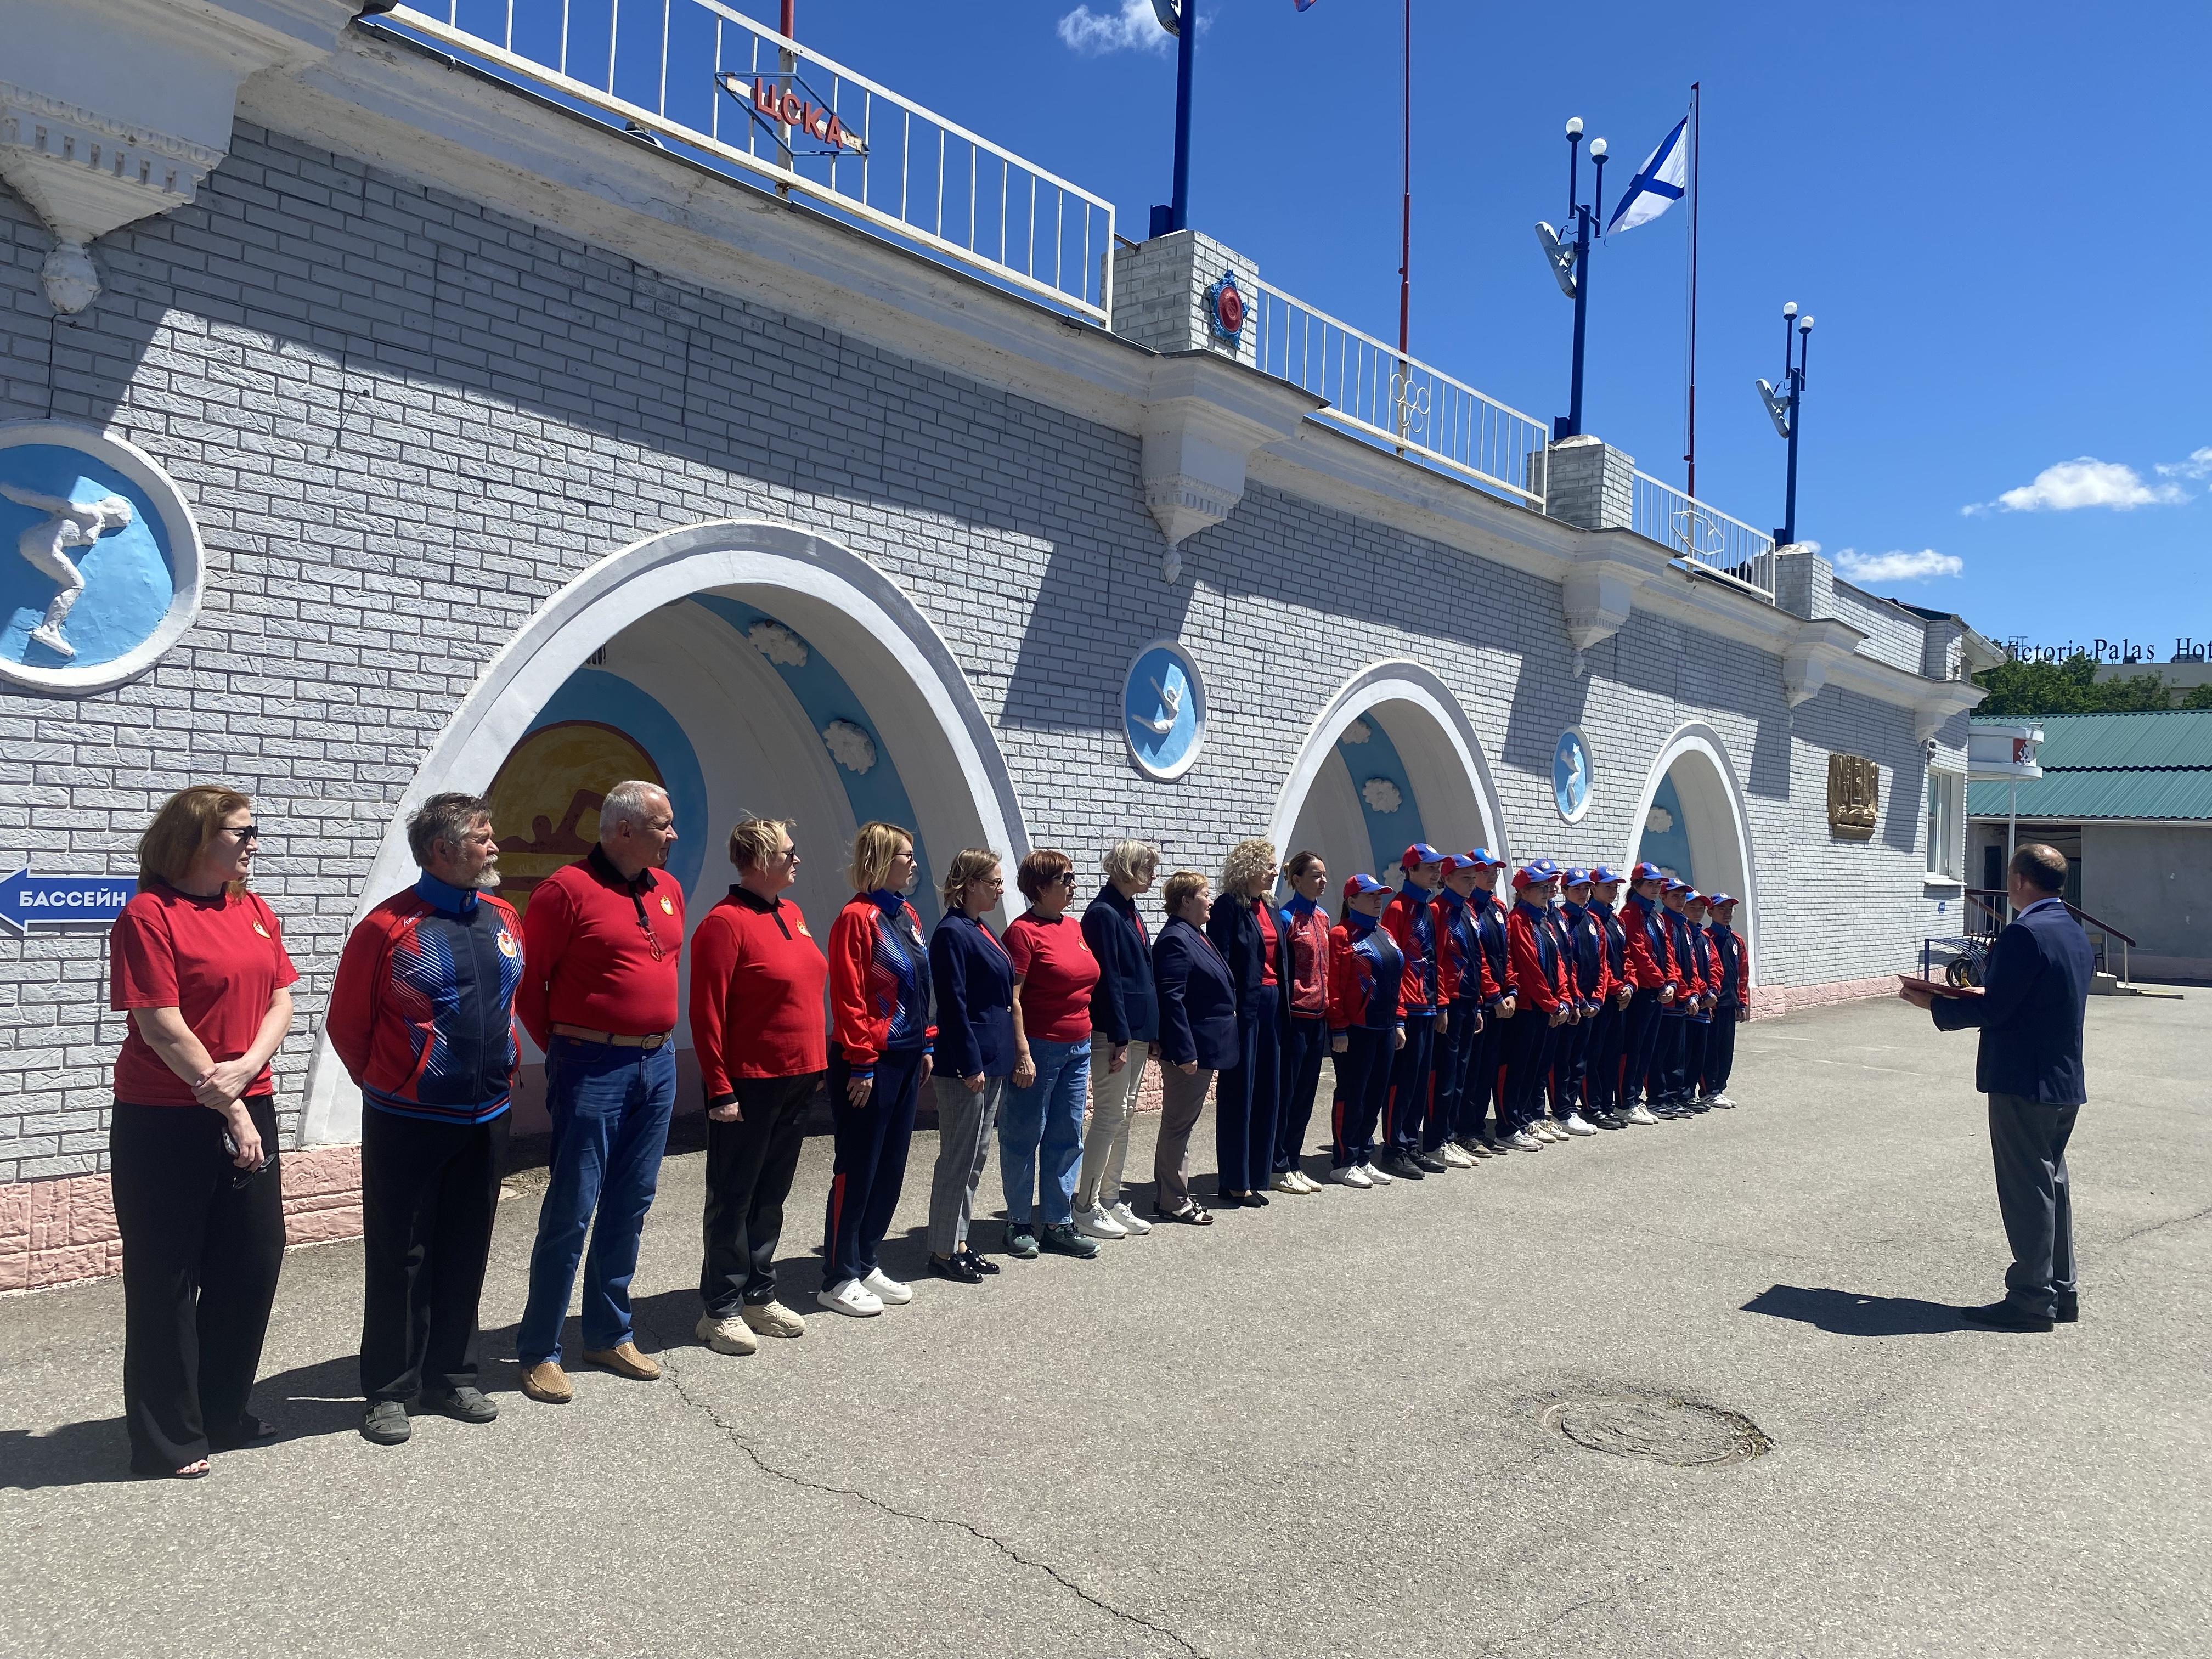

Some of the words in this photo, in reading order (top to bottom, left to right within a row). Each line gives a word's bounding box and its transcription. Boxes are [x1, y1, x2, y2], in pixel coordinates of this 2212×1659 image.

[754, 77, 843, 149] ЦСКА
[2094, 639, 2154, 659] Palas
[19, 887, 127, 907] БАССЕЙН
